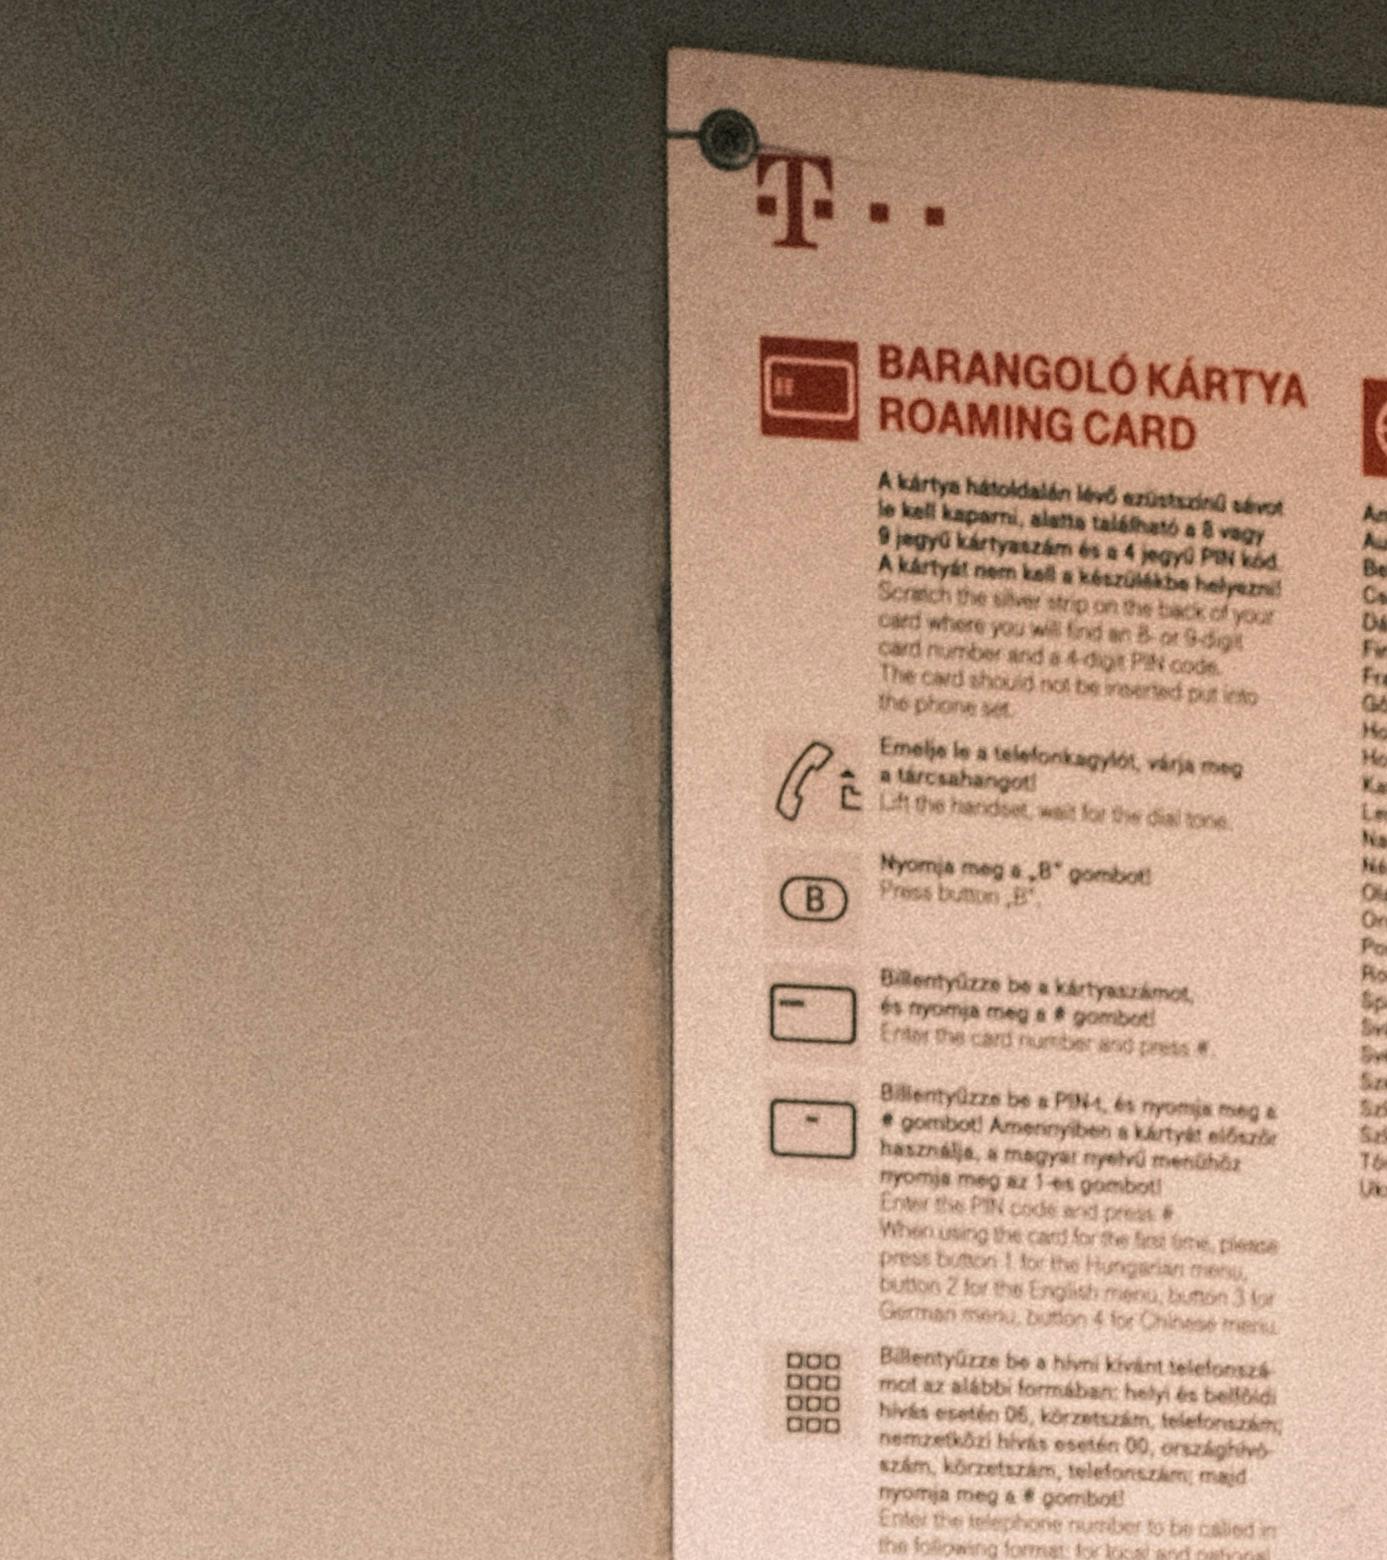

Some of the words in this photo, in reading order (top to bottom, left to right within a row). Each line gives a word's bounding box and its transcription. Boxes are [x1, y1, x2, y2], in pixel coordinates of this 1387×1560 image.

[879, 344, 1137, 395] BARANGOLÓ
[1146, 357, 1307, 408] KÁRTYA
[879, 398, 1073, 443] ROAMING
[1083, 411, 1198, 451] CARD
[877, 470, 892, 489] A
[896, 471, 960, 499] kártya
[877, 526, 891, 545] 9
[1220, 525, 1267, 548] vagy
[877, 553, 893, 572] A
[974, 564, 1015, 580] nem
[879, 736, 946, 764] Emelje
[952, 740, 970, 759] le
[1147, 752, 1195, 779] várja
[1199, 760, 1245, 782] meg
[879, 768, 891, 783] a
[879, 851, 955, 879] Nyomja
[960, 860, 1005, 882] meg
[1067, 863, 1153, 892] gombot!
[806, 885, 826, 914] B
[1006, 974, 1031, 994] be
[985, 1005, 1030, 1026] meg
[1072, 1005, 1157, 1033] gombot!
